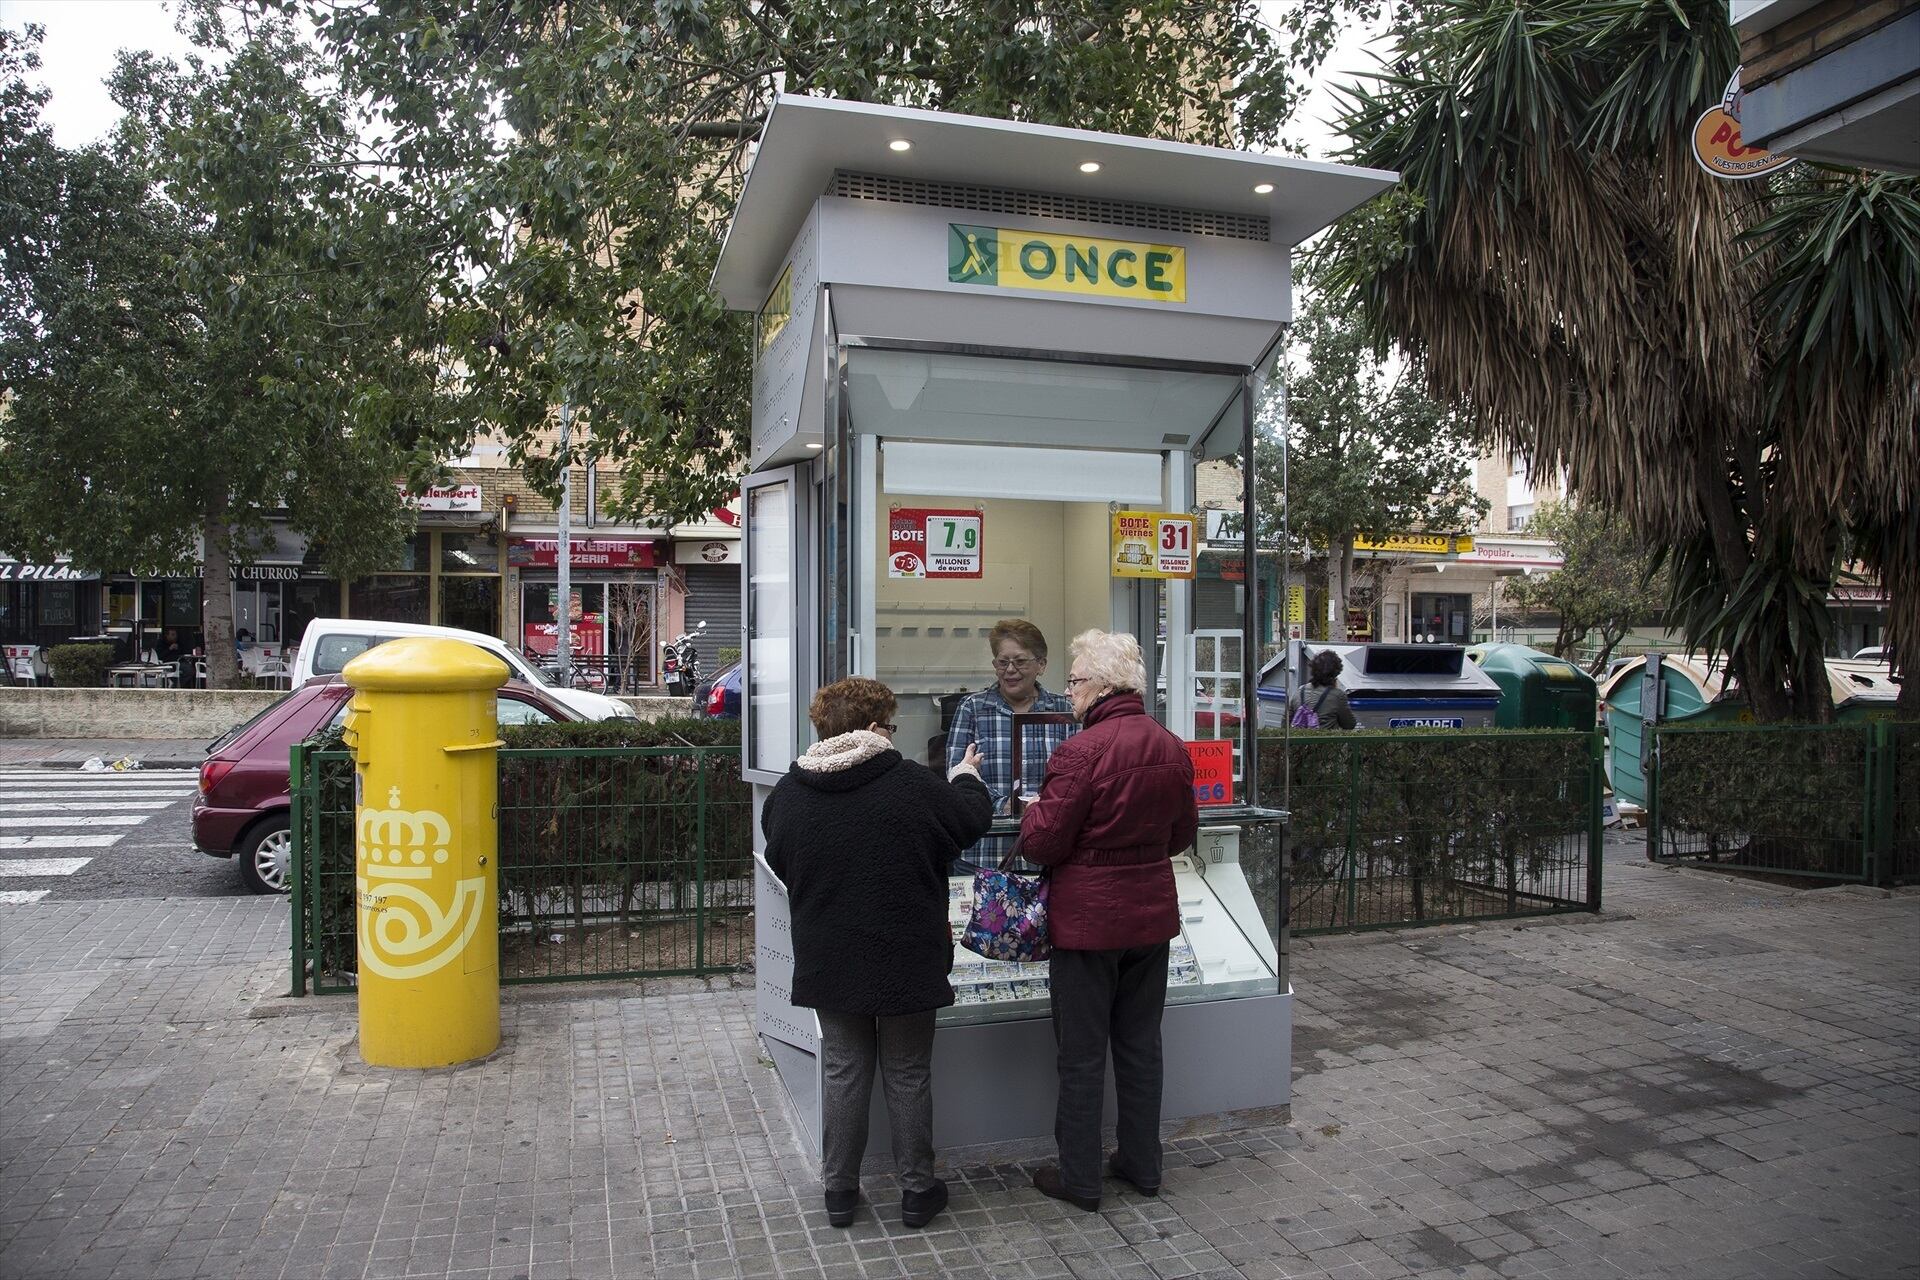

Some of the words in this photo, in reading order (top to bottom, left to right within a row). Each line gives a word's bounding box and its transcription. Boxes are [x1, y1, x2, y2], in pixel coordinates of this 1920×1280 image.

[1713, 156, 1747, 170] NUESTRO
[1747, 158, 1769, 169] BUEN
[1019, 240, 1173, 292] ONCE
[1120, 517, 1149, 529] BOTE
[892, 530, 924, 541] BOTE
[943, 522, 976, 549] 7,9
[1120, 528, 1154, 538] viernes
[1162, 524, 1188, 550] 31
[576, 542, 628, 552] KEBAB
[1478, 547, 1511, 559] Popular
[935, 558, 971, 566] MILLONES
[242, 567, 299, 579] CHURROS
[1188, 746, 1224, 757] UPON
[374, 895, 387, 904] 197
